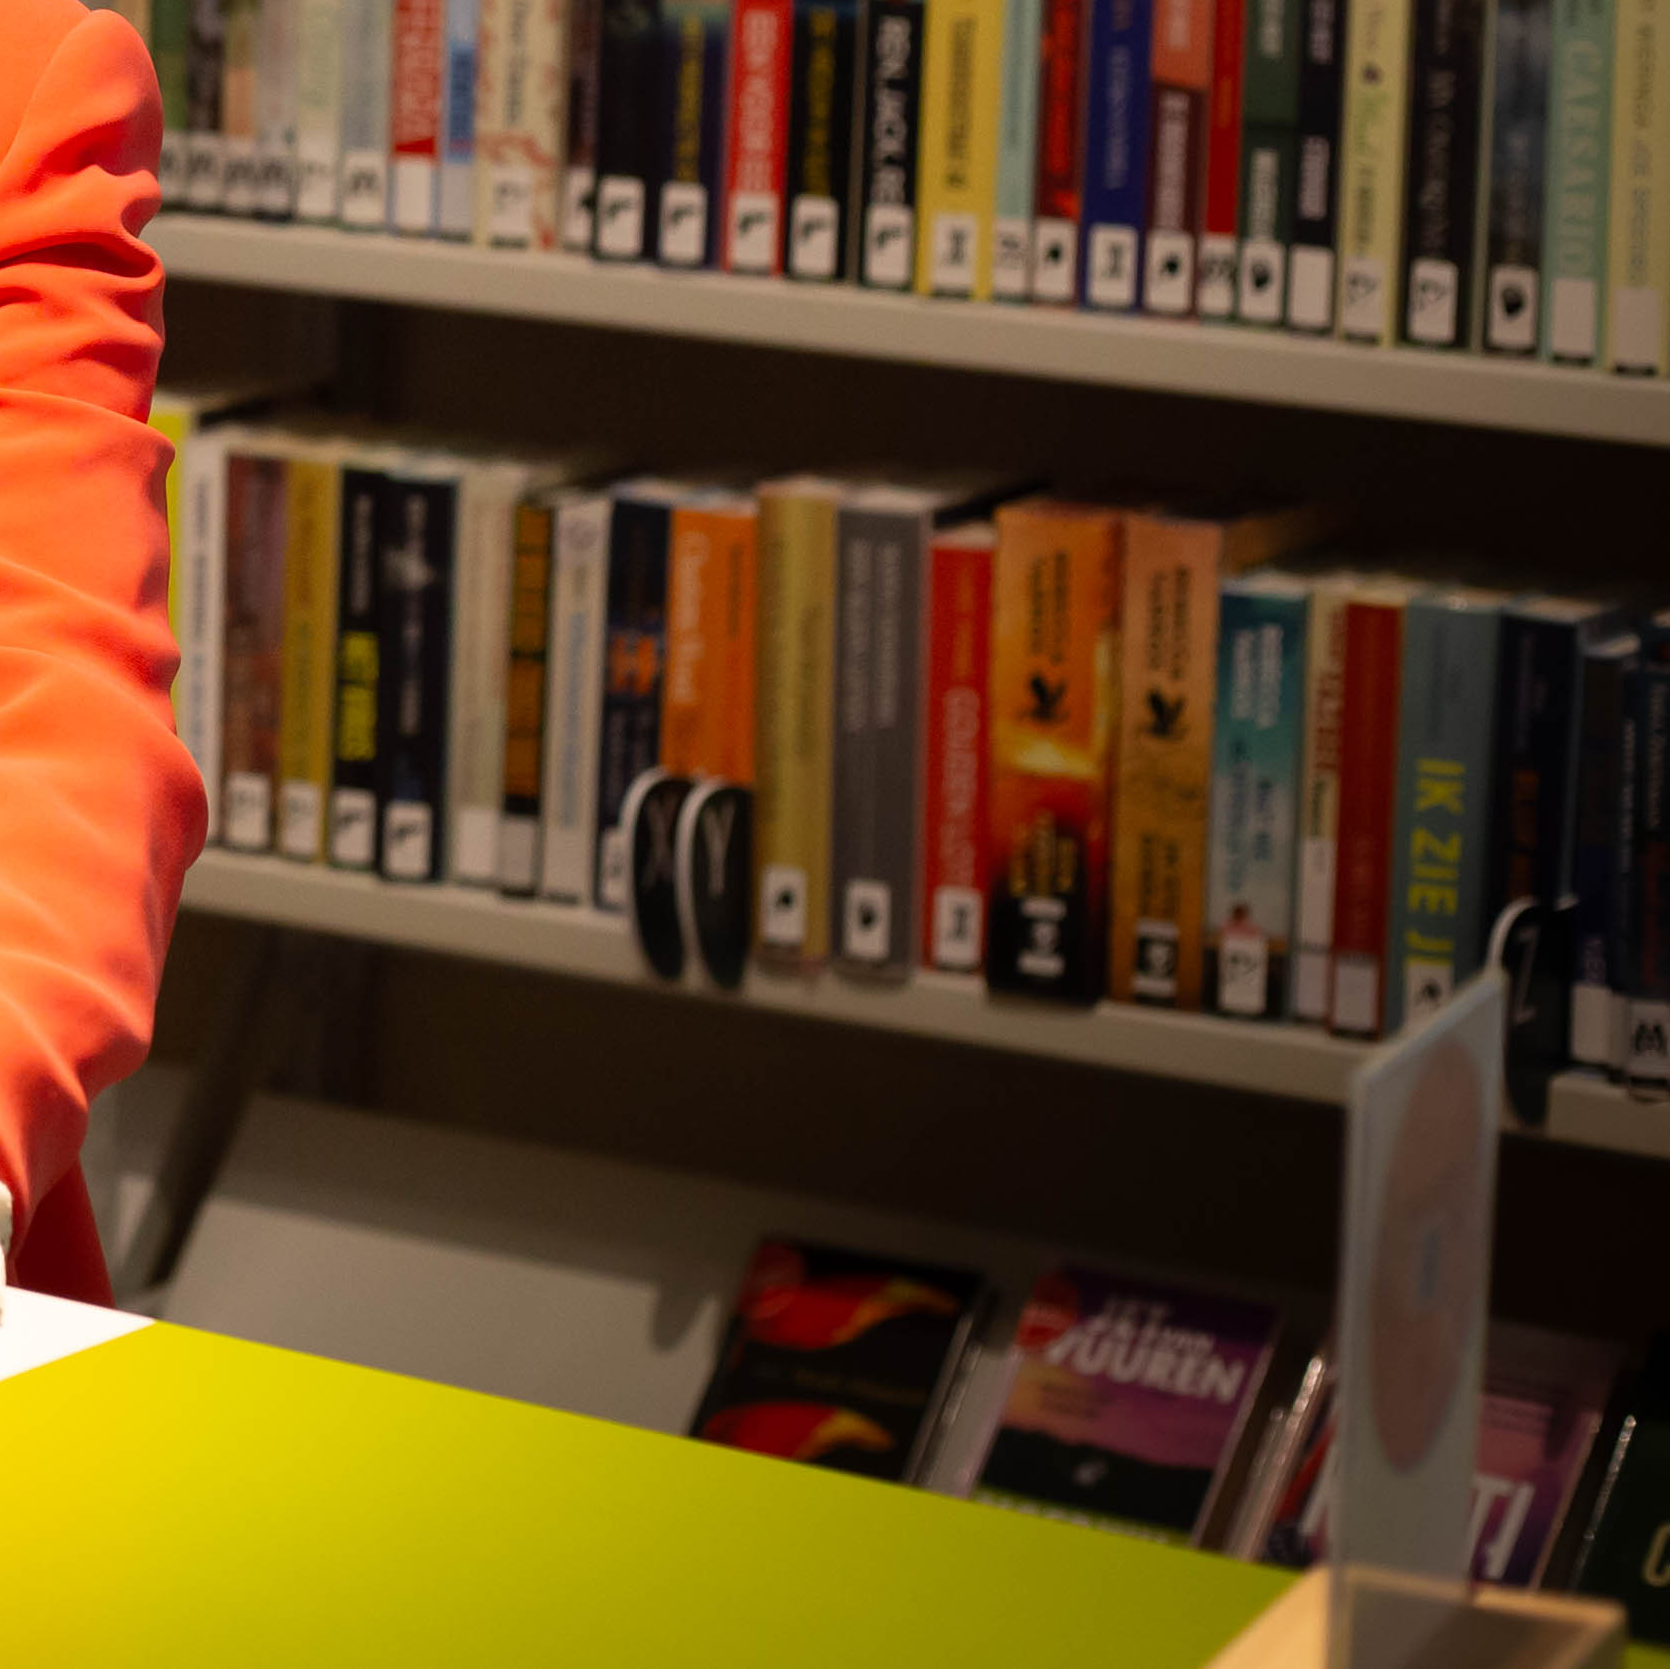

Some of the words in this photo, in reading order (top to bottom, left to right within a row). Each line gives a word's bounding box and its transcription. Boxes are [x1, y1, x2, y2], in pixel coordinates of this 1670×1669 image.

[1559, 39, 1604, 275] CAESARIO
[1413, 757, 1466, 814] IK
[1406, 827, 1461, 915] ZIE
